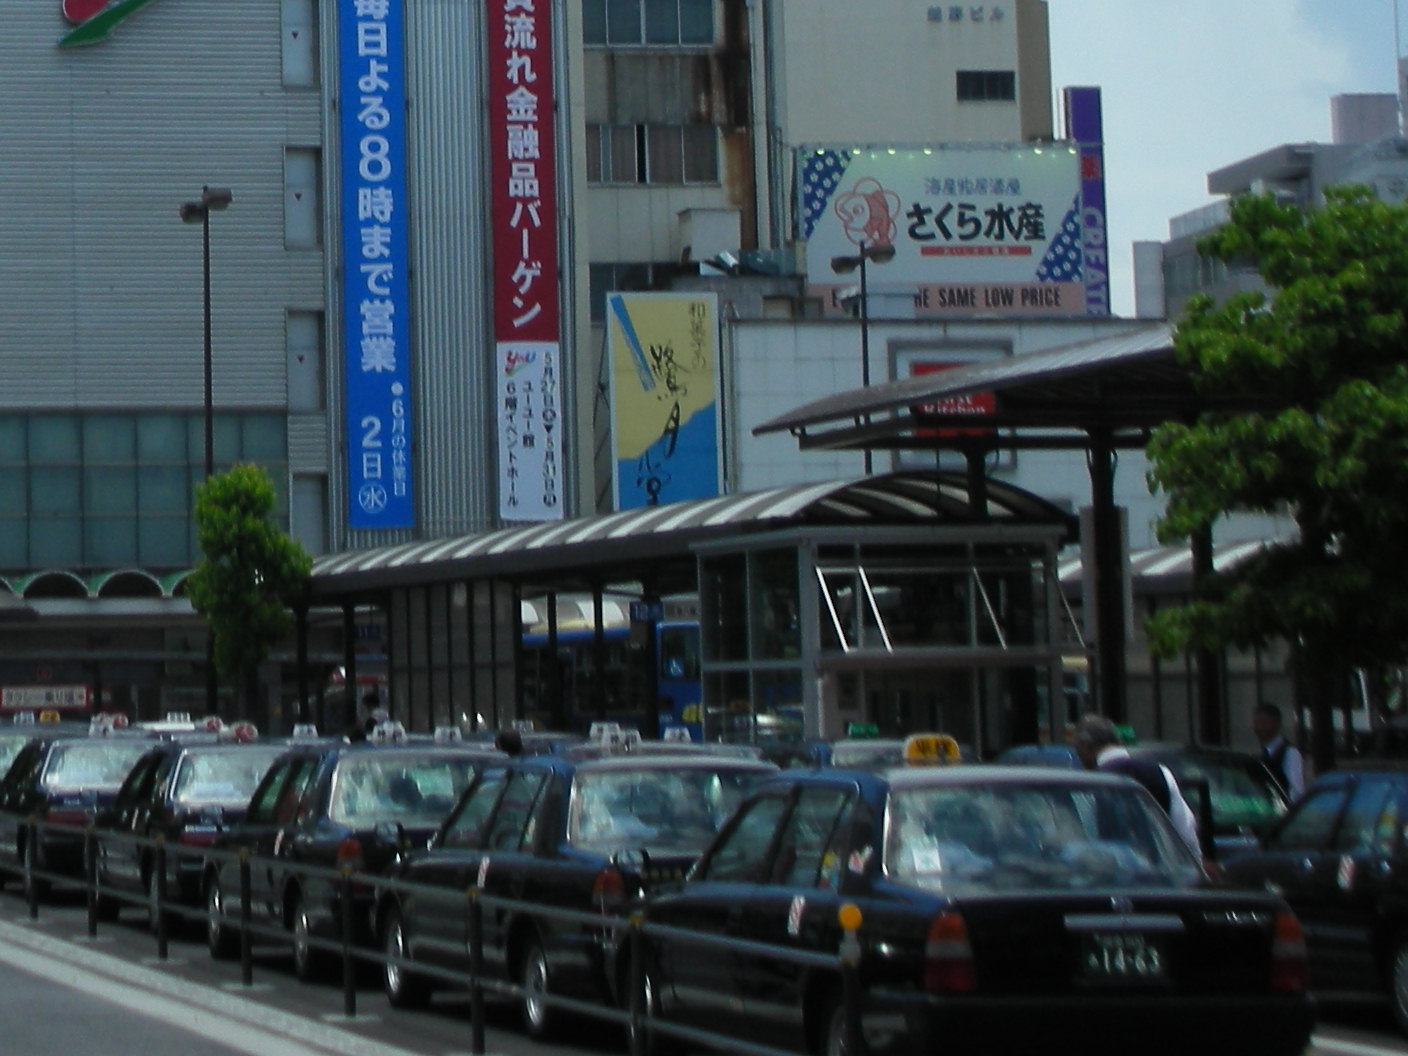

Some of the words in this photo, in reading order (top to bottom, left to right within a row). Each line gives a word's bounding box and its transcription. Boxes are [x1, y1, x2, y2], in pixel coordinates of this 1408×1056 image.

[924, 176, 1021, 196] 海産物居酒屋
[906, 200, 1046, 241] さくら水産
[938, 288, 976, 307] SAME
[985, 288, 1014, 307] LOW
[1021, 287, 1061, 307] PRICE
